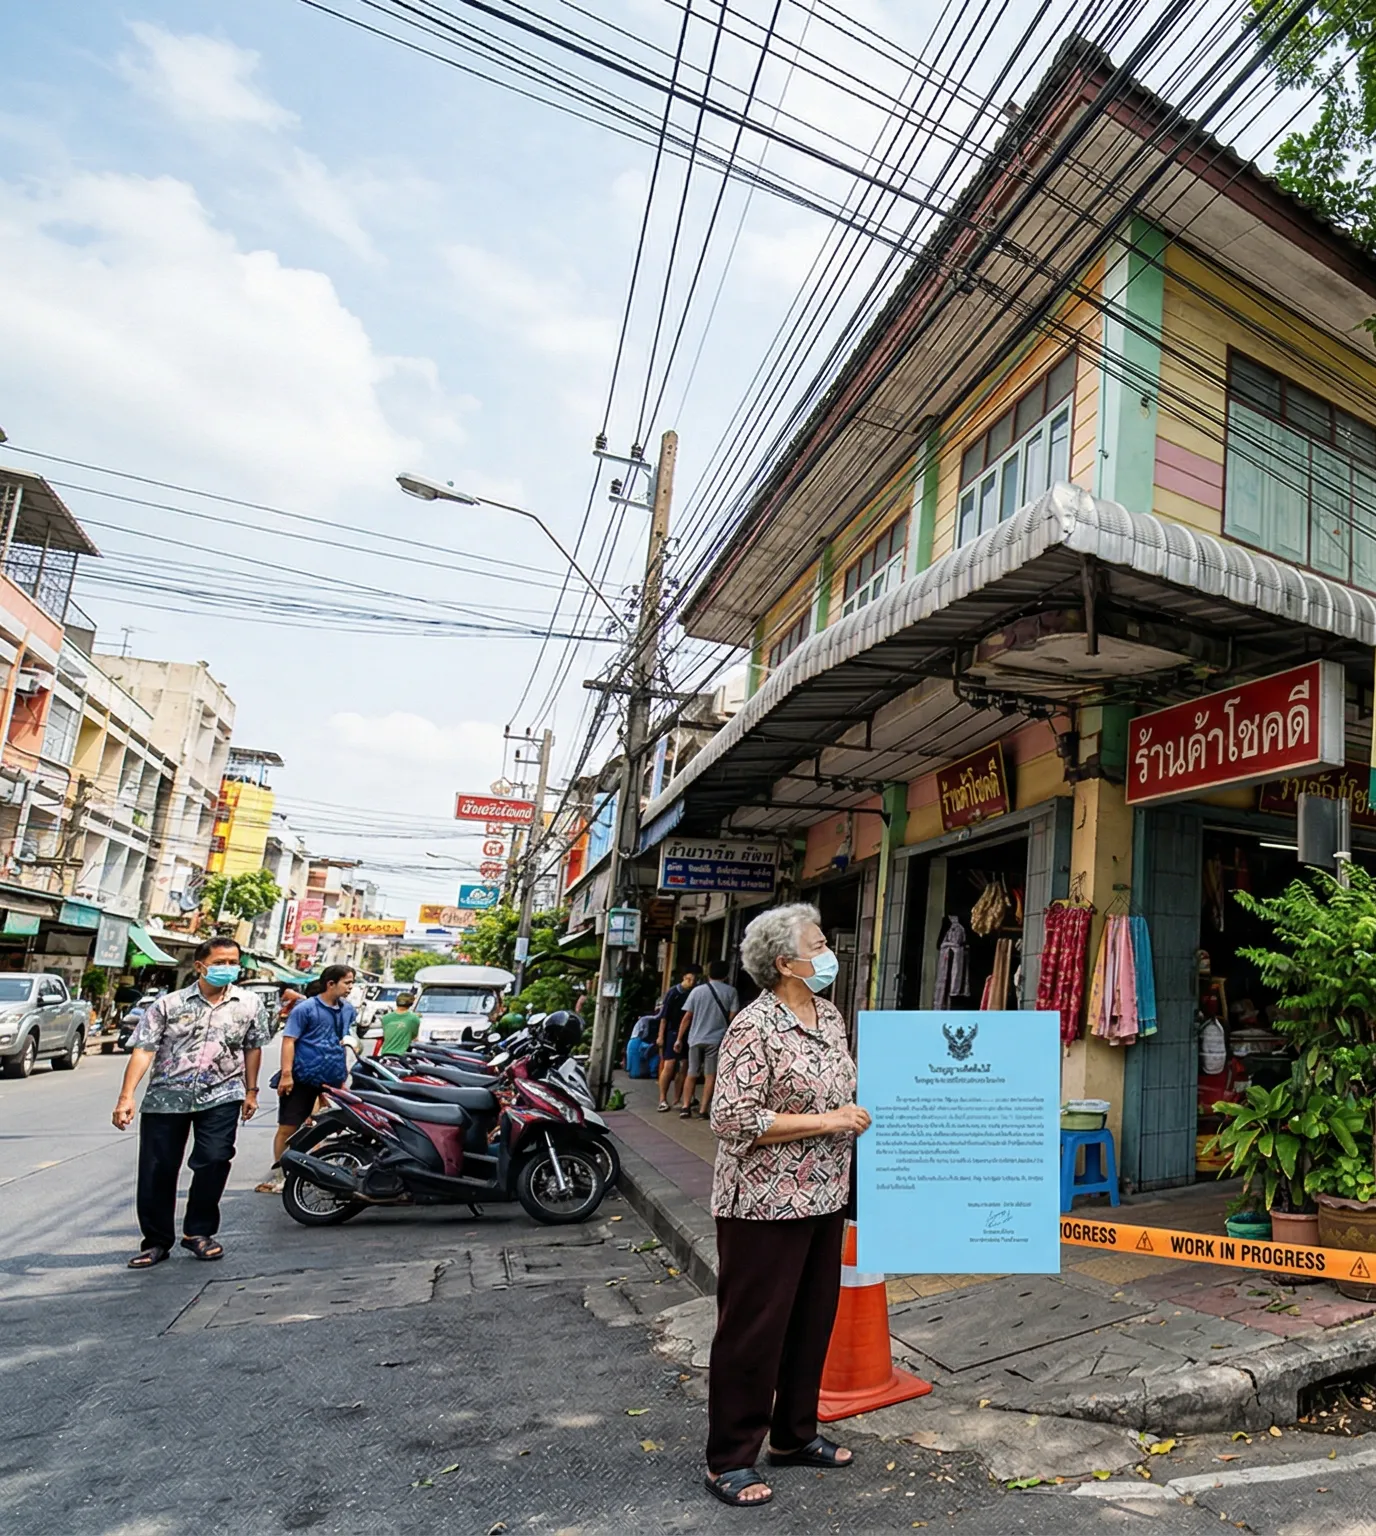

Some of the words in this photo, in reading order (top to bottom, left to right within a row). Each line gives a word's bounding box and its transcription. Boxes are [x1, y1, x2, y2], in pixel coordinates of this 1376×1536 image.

[1135, 679, 1310, 784] ร้านค้าโชคดี
[1060, 1222, 1117, 1244] OGRESS
[1171, 1236, 1214, 1258] WORK
[1220, 1243, 1235, 1260] IN
[1241, 1244, 1325, 1271] PROGRESS
